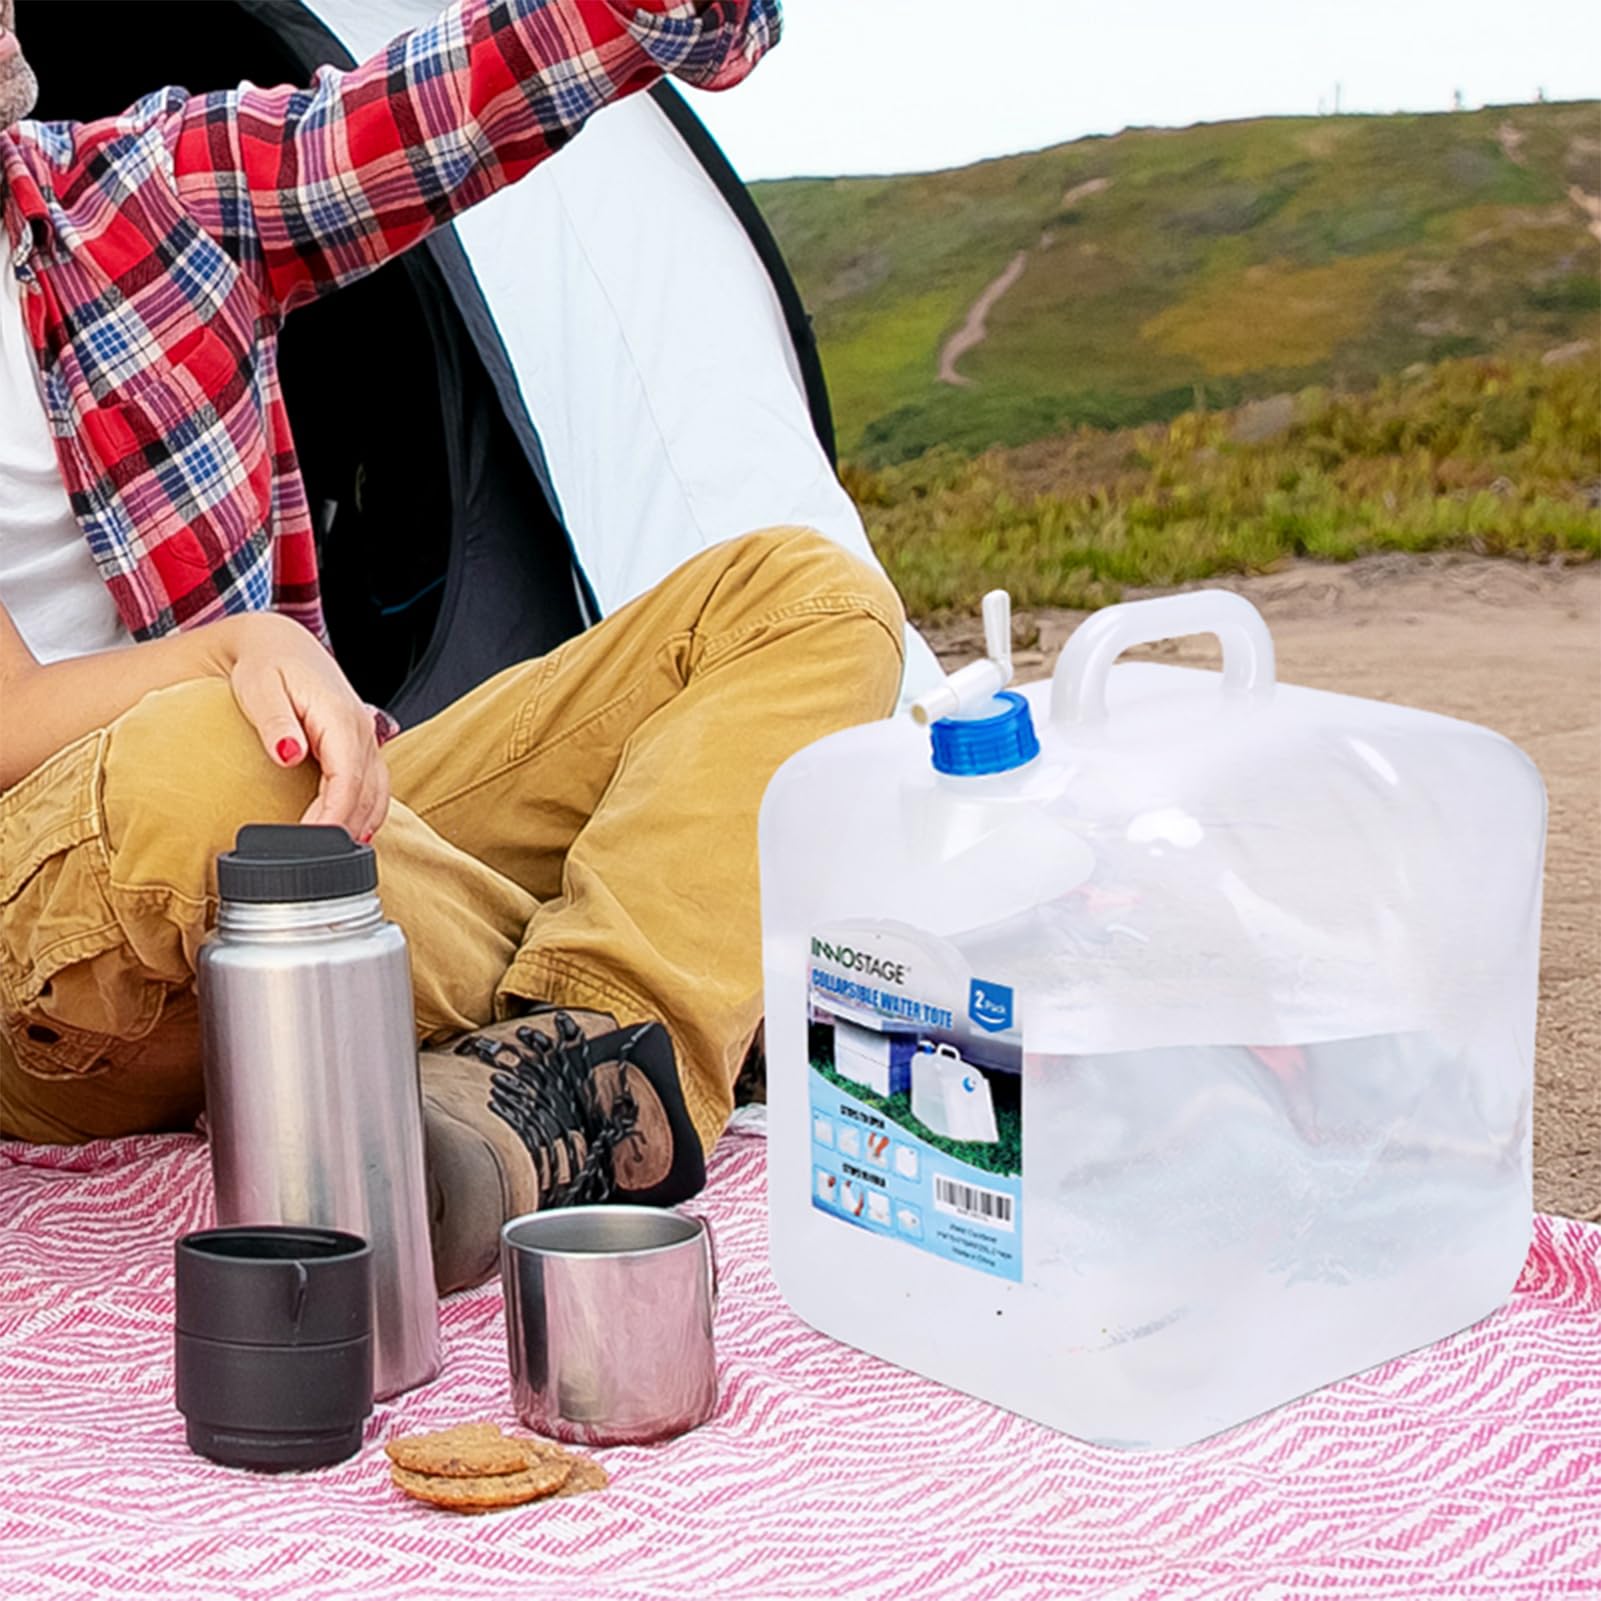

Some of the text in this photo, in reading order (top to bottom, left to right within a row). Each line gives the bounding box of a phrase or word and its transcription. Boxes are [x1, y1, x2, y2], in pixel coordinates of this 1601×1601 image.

[811, 936, 904, 985] INNOSTAGE
[812, 968, 953, 1029] COLLAPSIBLE WATER TOTE
[975, 989, 985, 1009] 2
